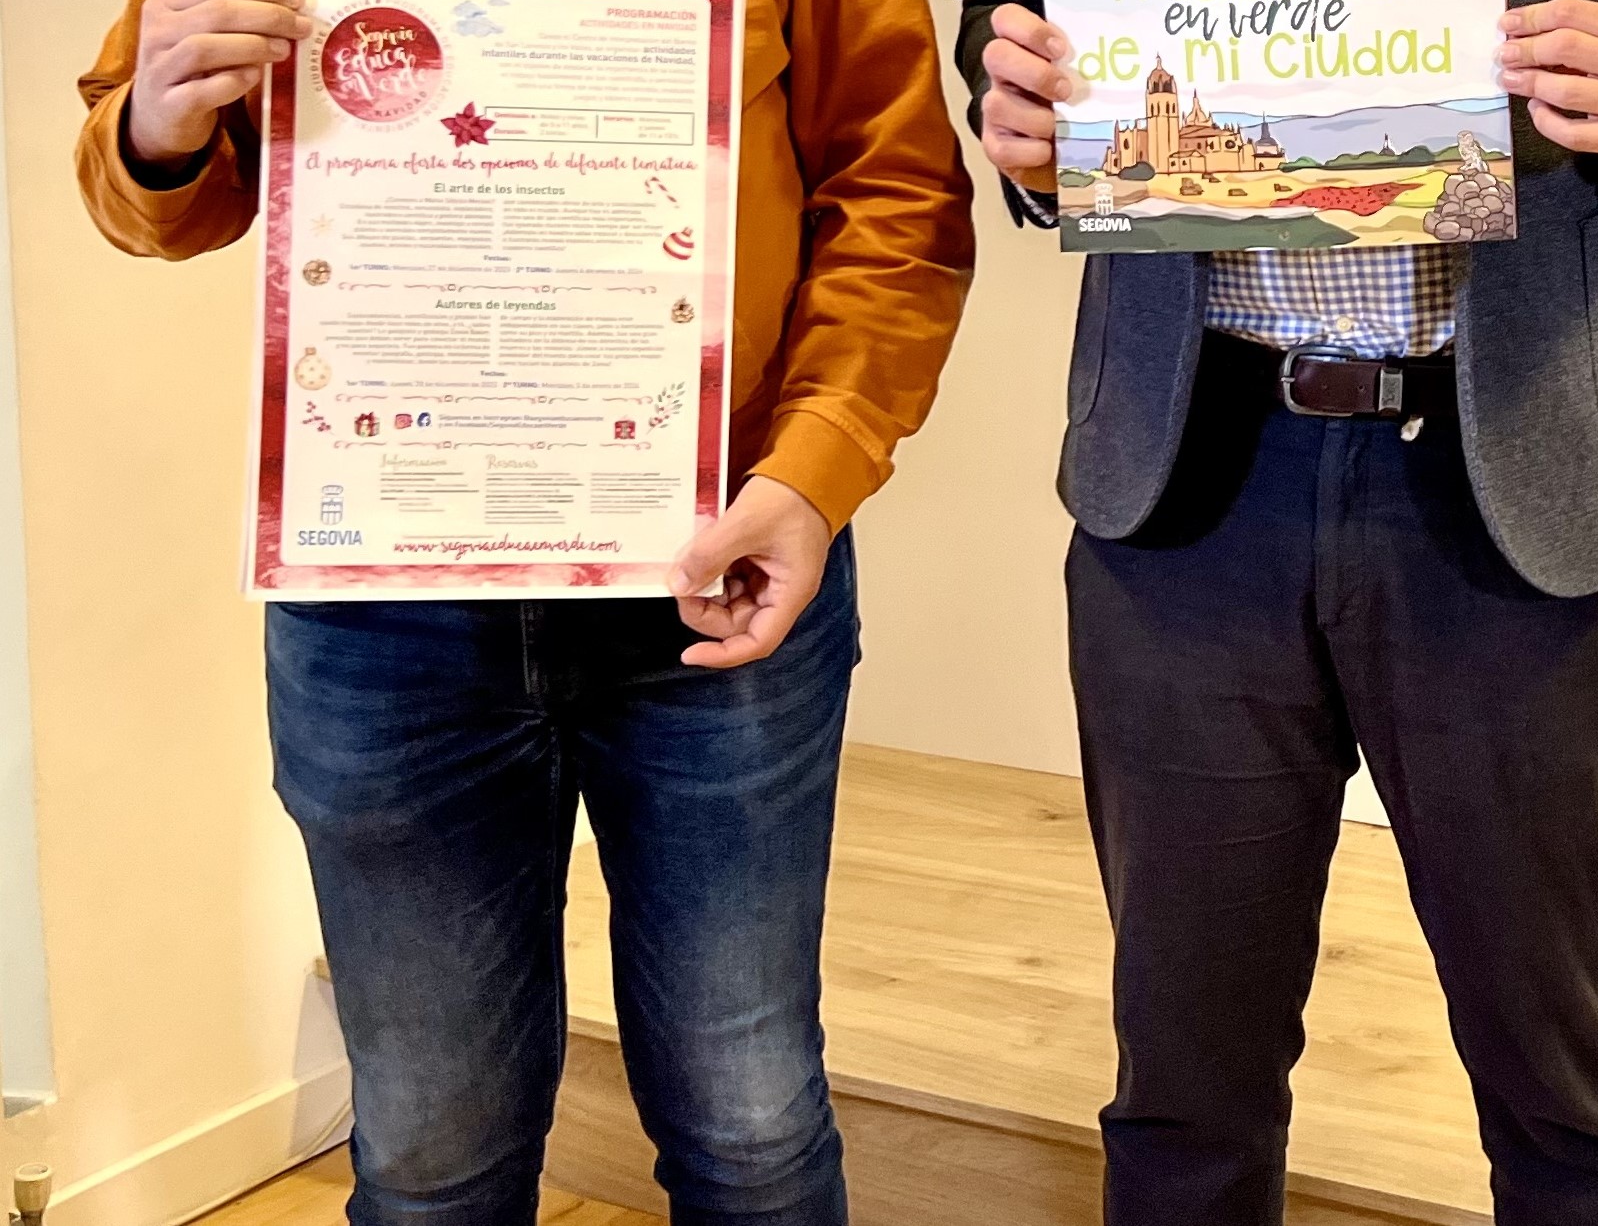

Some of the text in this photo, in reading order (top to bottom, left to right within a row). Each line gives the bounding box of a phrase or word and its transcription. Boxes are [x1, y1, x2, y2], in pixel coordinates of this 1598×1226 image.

[1164, 0, 1219, 41] en
[1079, 36, 1140, 81] de
[1185, 37, 1239, 82] mi
[327, 157, 398, 176] programa
[403, 152, 448, 174] oferta
[452, 151, 475, 170] dos
[481, 157, 538, 178] opciones
[544, 151, 560, 169] de
[565, 152, 628, 175] diferente
[434, 182, 566, 195] El arte de los insectos
[1079, 217, 1131, 233] SEGOVIA
[435, 299, 556, 312] Autores de leyendas
[298, 530, 362, 545] SEGOVIA
